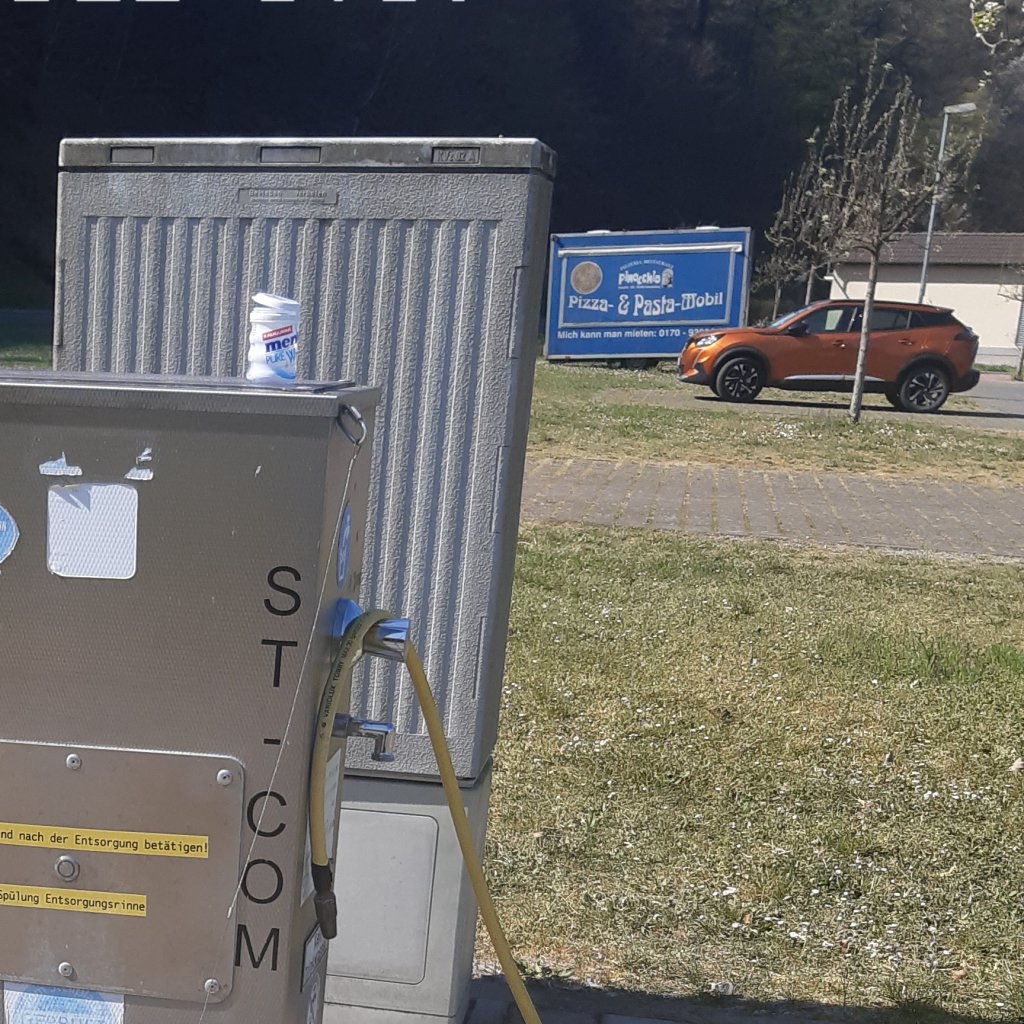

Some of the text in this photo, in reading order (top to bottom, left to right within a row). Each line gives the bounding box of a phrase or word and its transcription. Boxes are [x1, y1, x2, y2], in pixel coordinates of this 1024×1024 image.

[568, 292, 723, 316] Pizza- & Pasta-Mobil
[557, 330, 578, 339] Mich
[580, 330, 602, 339] kann
[624, 329, 657, 338] mieten:
[659, 328, 680, 337] 0170
[18, 831, 44, 842] nach
[50, 832, 69, 844] der
[74, 834, 139, 851] Entsorgung
[144, 839, 208, 853] betätigen!
[45, 893, 146, 912] Entsorgungsrinne
